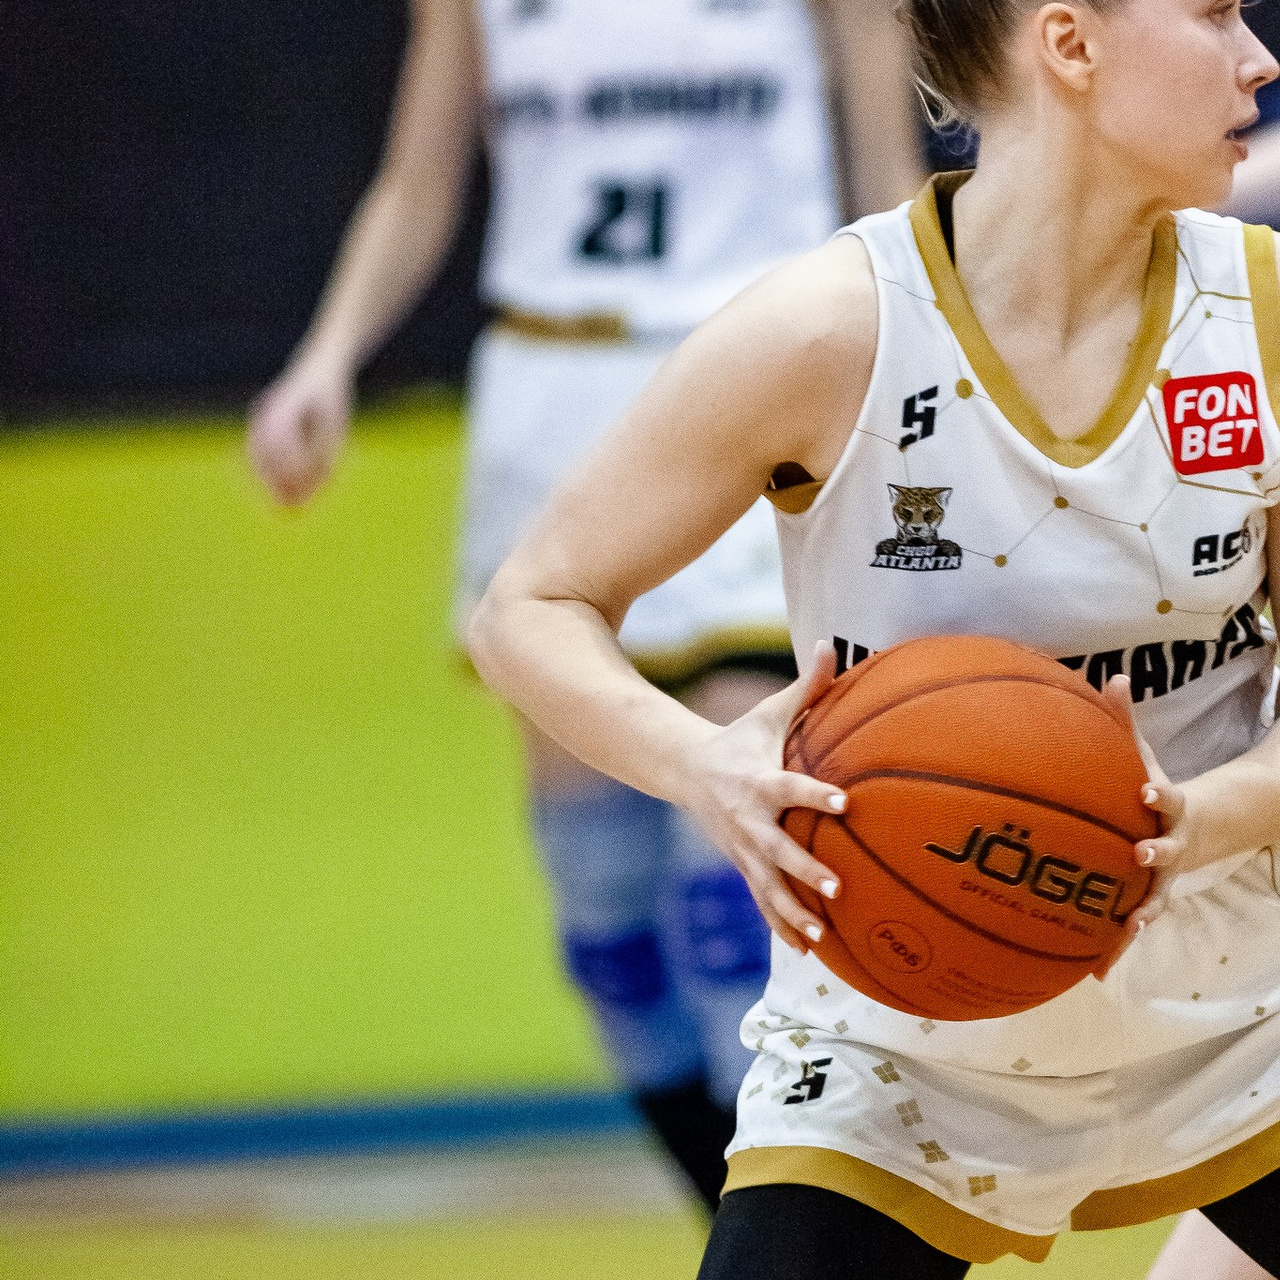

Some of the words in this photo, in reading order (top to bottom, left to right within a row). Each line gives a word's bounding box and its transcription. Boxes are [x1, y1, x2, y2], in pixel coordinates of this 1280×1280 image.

[900, 385, 939, 448] 5
[1173, 383, 1254, 425] FON
[1180, 418, 1259, 462] BET
[872, 554, 961, 570] ATLANTA
[923, 822, 1129, 928] JÖGEL
[783, 1057, 834, 1106] 5
